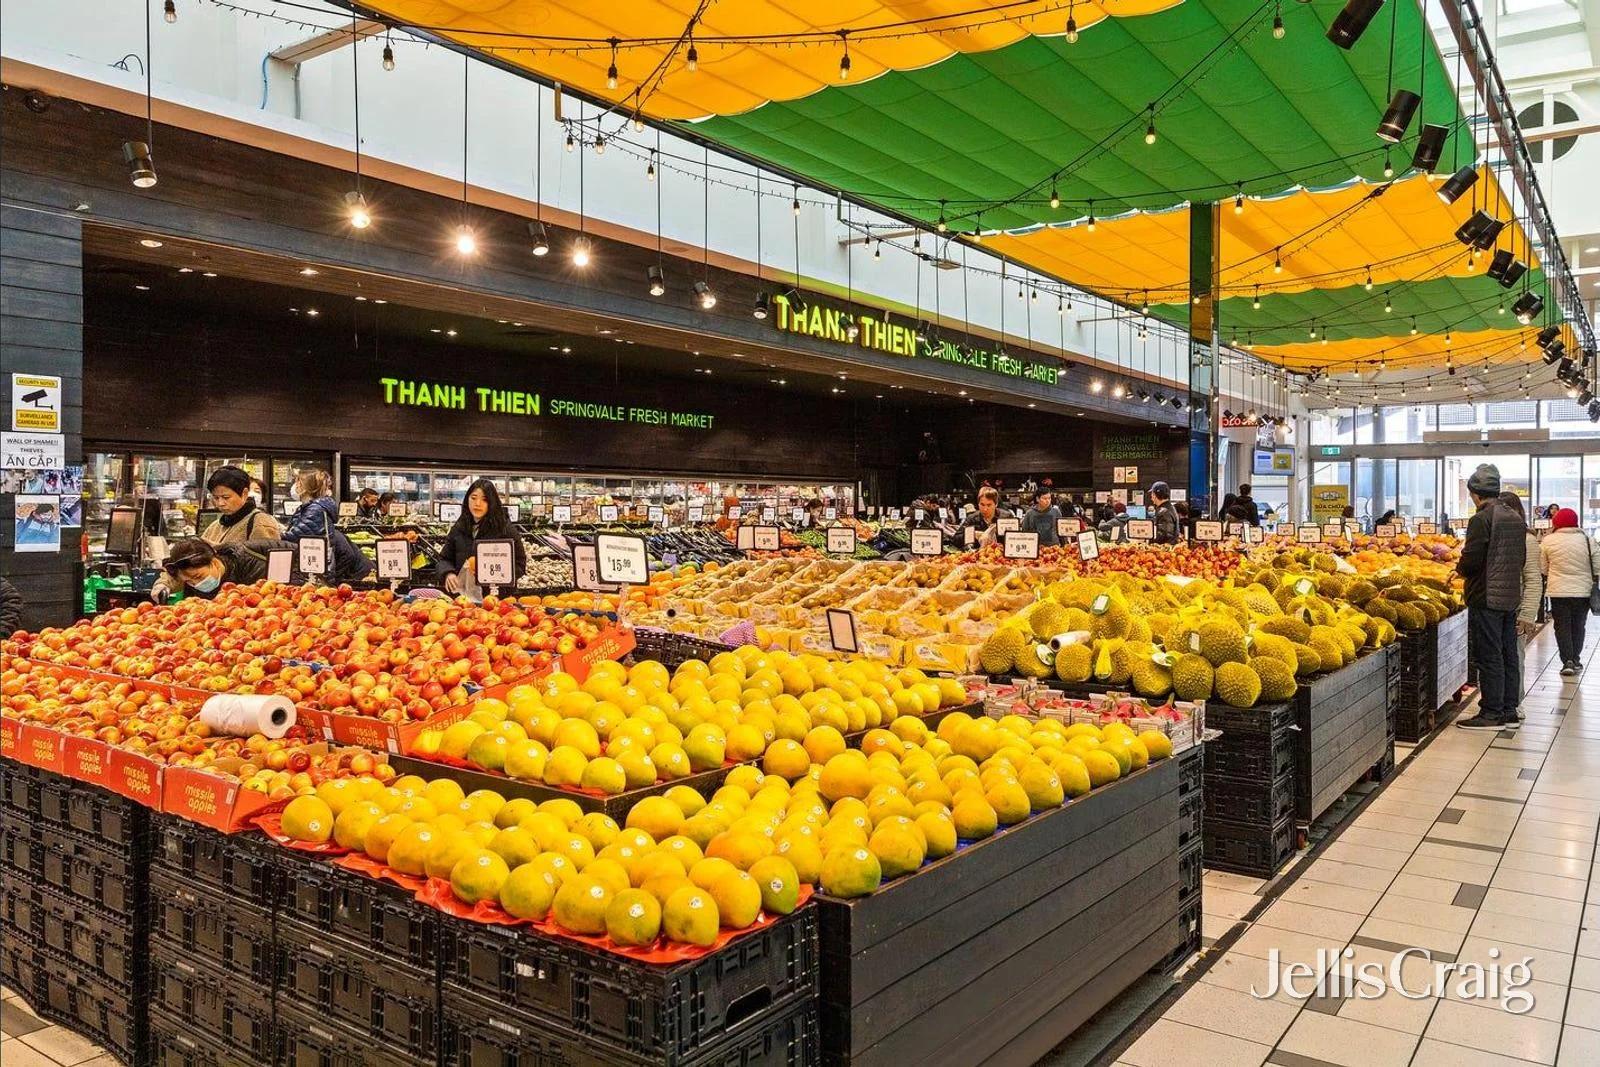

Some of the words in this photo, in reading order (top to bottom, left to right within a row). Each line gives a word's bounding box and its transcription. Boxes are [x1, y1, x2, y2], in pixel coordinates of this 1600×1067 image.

[859, 316, 916, 357] THIEN
[992, 354, 1022, 376] FRESH
[380, 378, 466, 409] THANH
[476, 387, 540, 415] THIEN
[550, 399, 625, 421] SPRINGVALE
[629, 407, 667, 424] FRESH
[671, 413, 714, 429] MARKET
[77, 746, 100, 764] missile
[80, 760, 102, 775] apples
[123, 763, 149, 783] missile
[126, 777, 151, 795] apples
[184, 782, 216, 803] missile
[188, 798, 217, 815] apples
